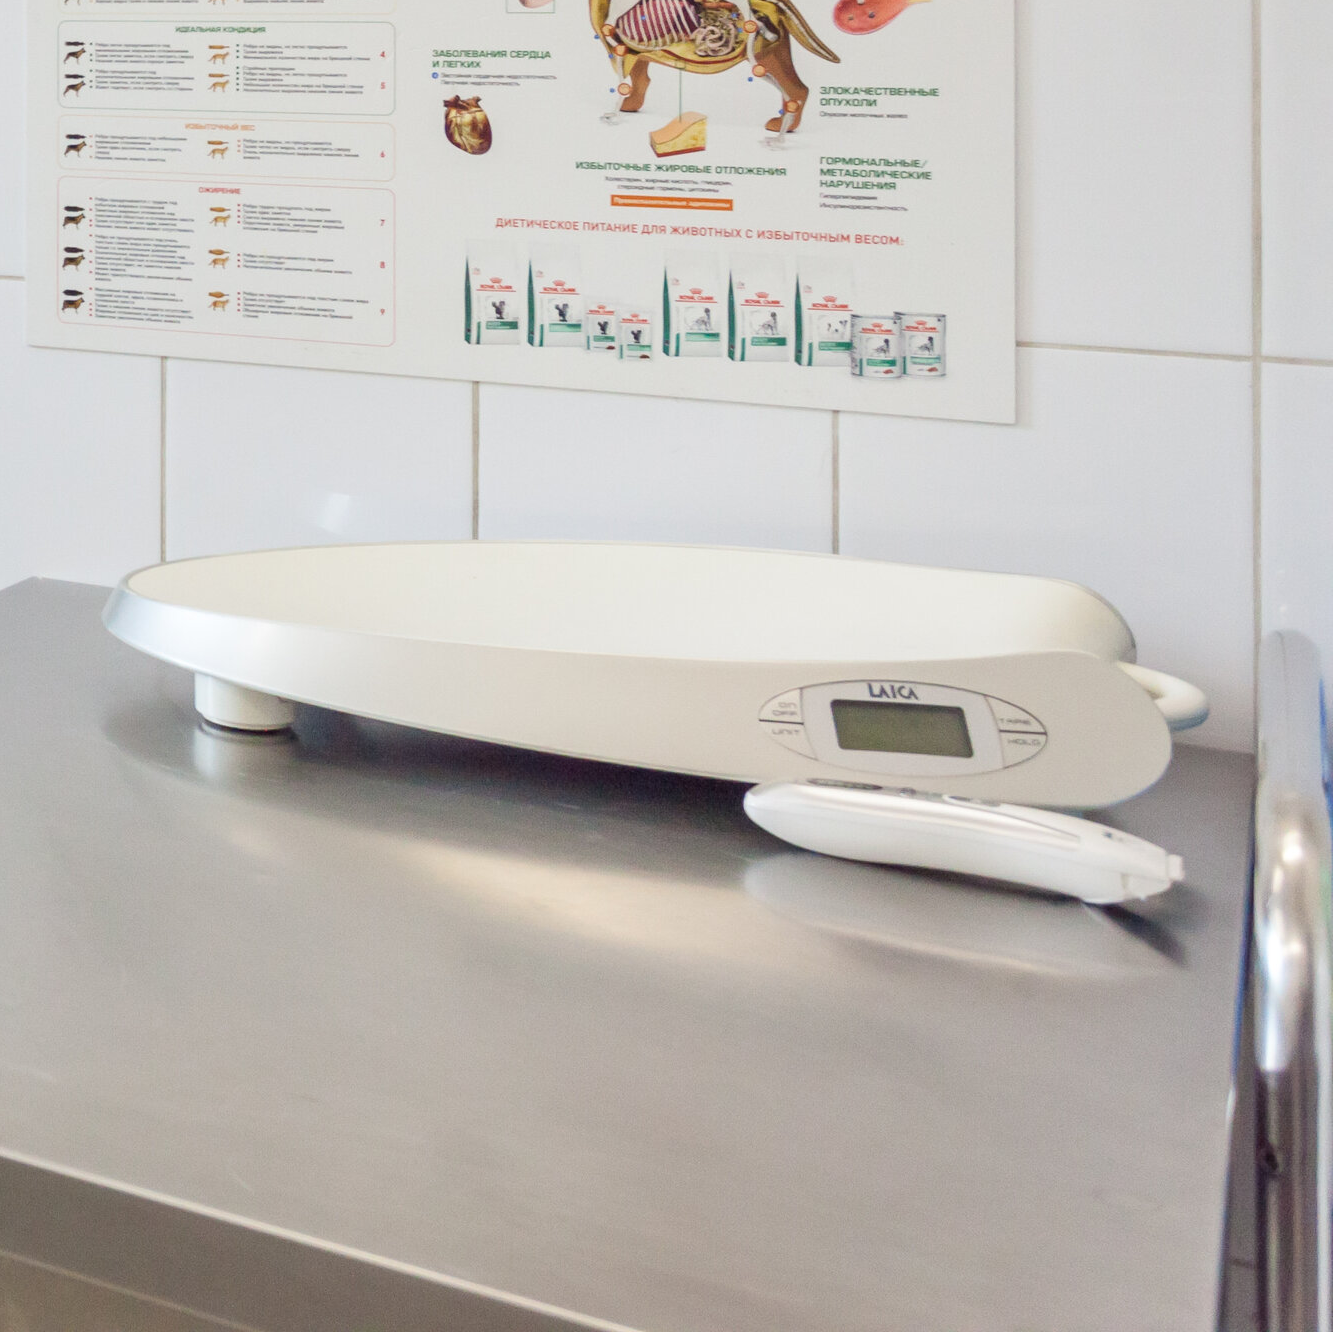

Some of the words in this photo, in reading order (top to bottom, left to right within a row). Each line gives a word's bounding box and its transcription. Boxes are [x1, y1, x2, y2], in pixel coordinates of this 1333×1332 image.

[433, 49, 506, 57] ЗАБОЛЕВАНИЯ
[510, 50, 550, 59] СЕРДЦА
[442, 60, 479, 68] ЛЕГКИХ
[819, 86, 940, 99] ЗЛОКАЧЕСТВЕННЫЕ
[820, 97, 876, 106] ОПУХОЛИ
[575, 161, 650, 171] ИЗБЫТОЧНЫЕ
[655, 164, 711, 173] ЖИРОВЫЕ
[715, 166, 786, 175] ОТЛОЖЕНИЯ
[820, 168, 930, 182] МЕТАБОЛИЧЕСКИЕ
[820, 180, 895, 189] НАРУШЕНИЯ
[495, 217, 578, 230] ДИЕТИЧЕСКОЕ
[583, 221, 637, 233] ПИТАНИЕ
[641, 224, 666, 234] ДЛЯ
[670, 226, 741, 237] ЖИВОТНЫХ
[745, 228, 752, 238] С
[757, 230, 850, 242] ИЗБЫТОЧНЫМ
[868, 683, 919, 701] LAICA
